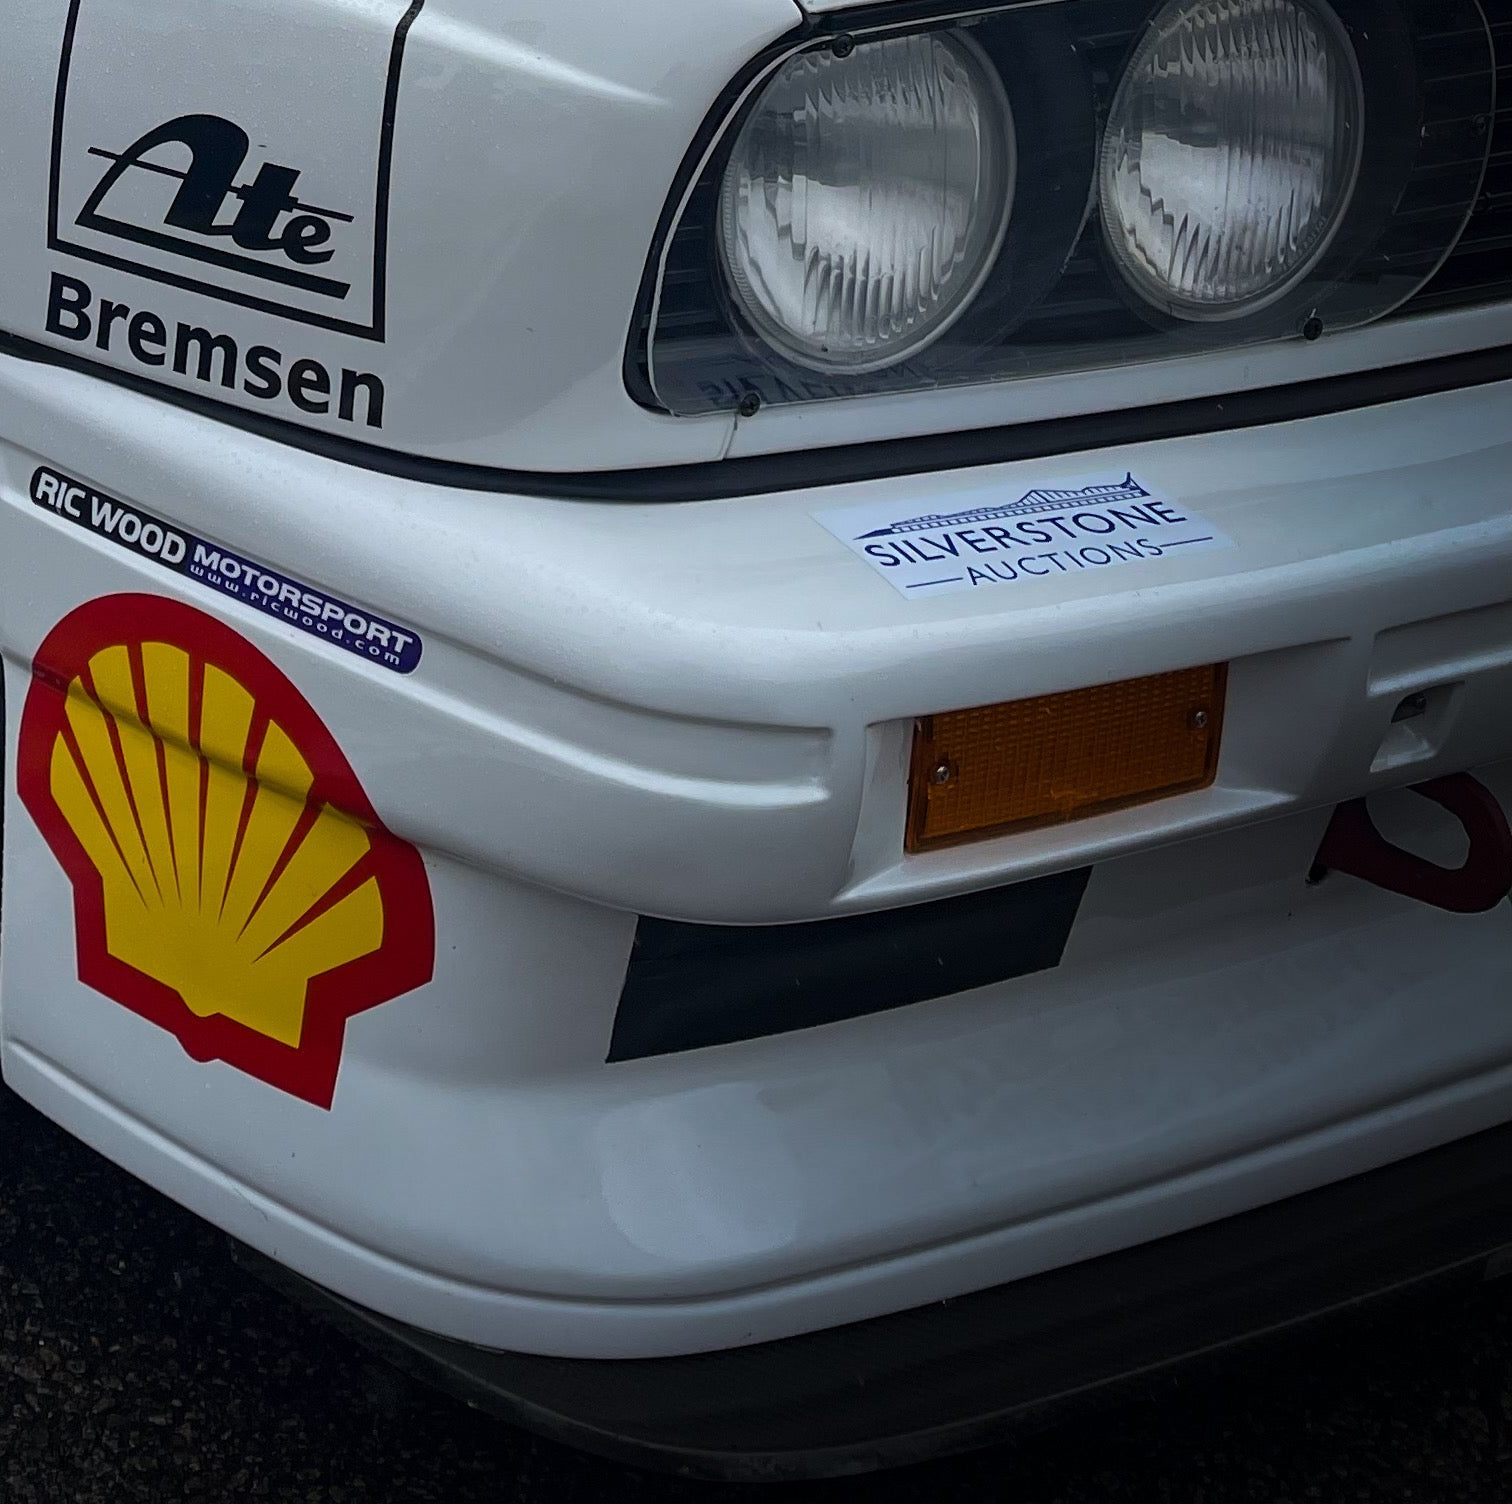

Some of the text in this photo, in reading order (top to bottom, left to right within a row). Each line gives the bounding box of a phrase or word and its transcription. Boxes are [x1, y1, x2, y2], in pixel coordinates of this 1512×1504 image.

[75, 113, 354, 265] Ate
[44, 270, 386, 429] Bremsen
[35, 471, 414, 653] RIC WOOD MOTORSPORT
[864, 500, 1188, 568] SILVERSTONE
[967, 537, 1164, 587] AUCTIONS
